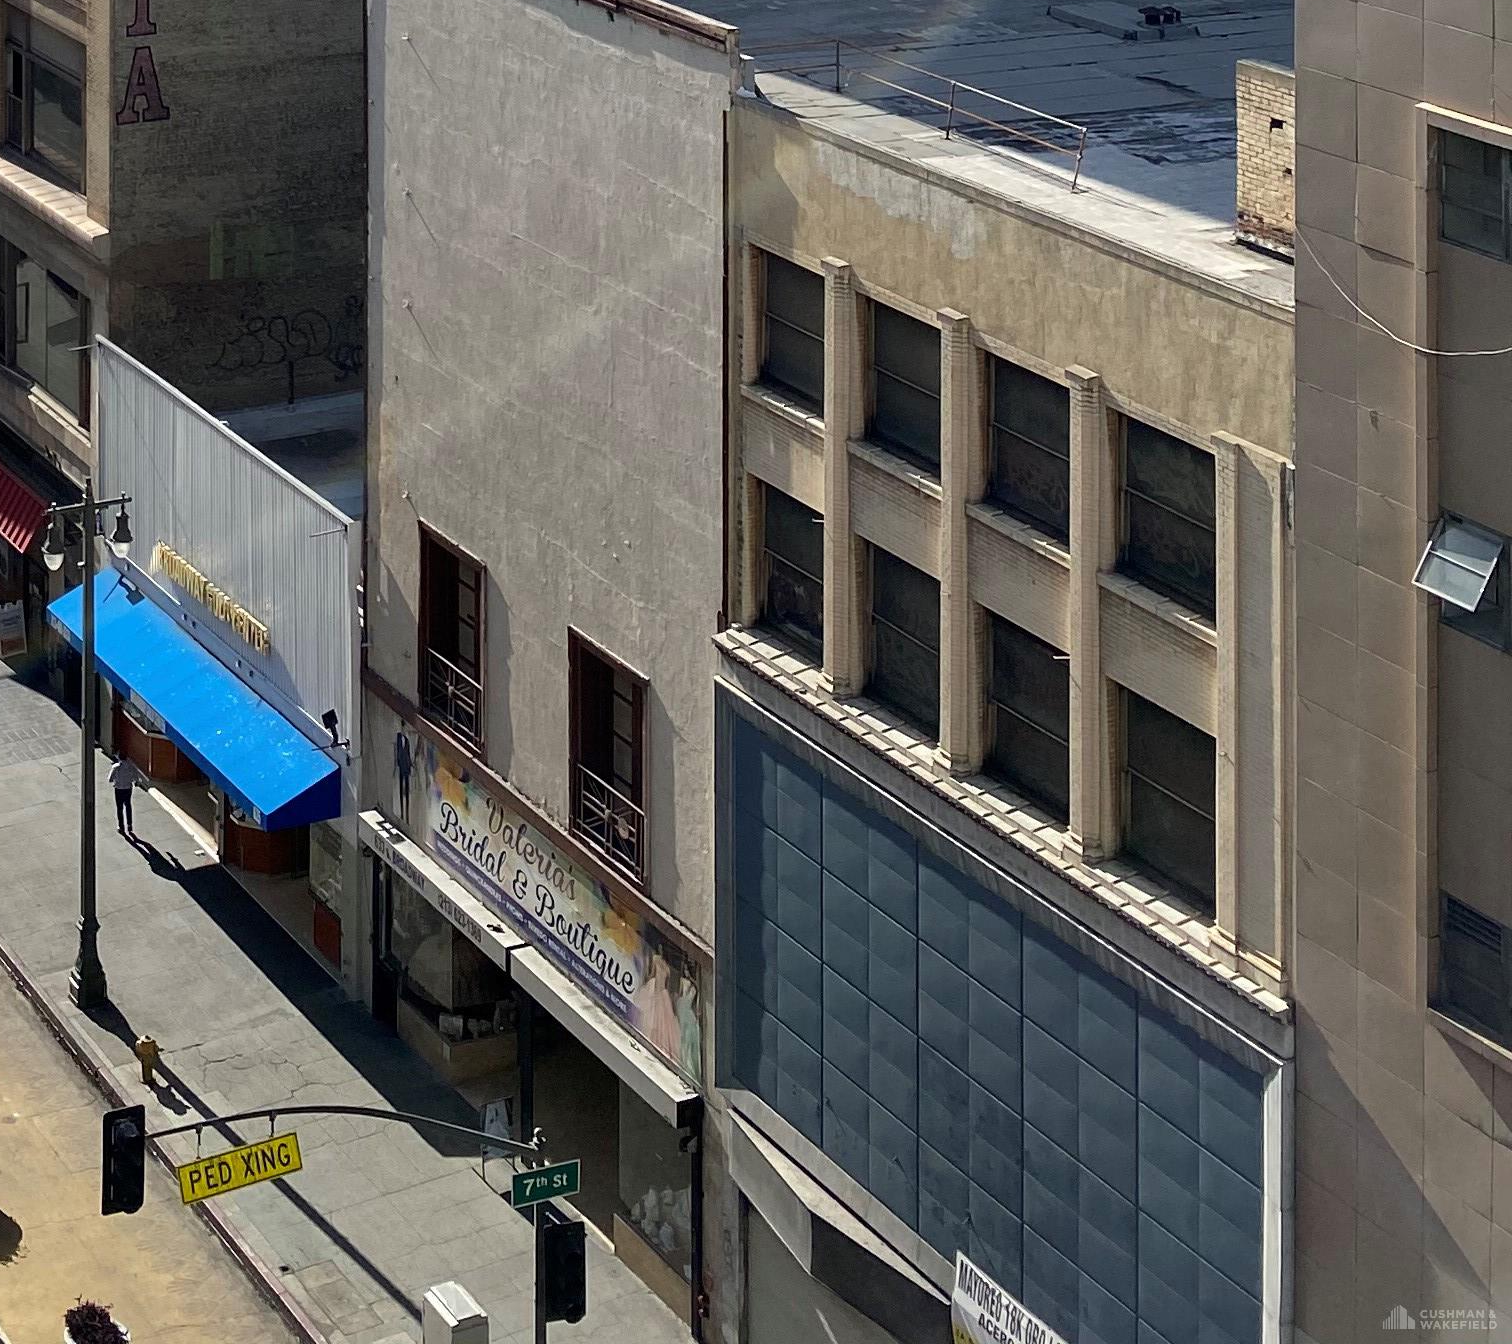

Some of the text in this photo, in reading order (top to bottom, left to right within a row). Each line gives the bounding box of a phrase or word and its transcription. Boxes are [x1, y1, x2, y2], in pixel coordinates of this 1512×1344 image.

[486, 797, 576, 901] Valeria's
[440, 802, 636, 995] Bridal & Boutique
[189, 1143, 291, 1194] PED XING
[523, 1173, 568, 1197] 7th St
[958, 1259, 1002, 1323] MAYOREO
[1003, 1302, 1025, 1341] 18K
